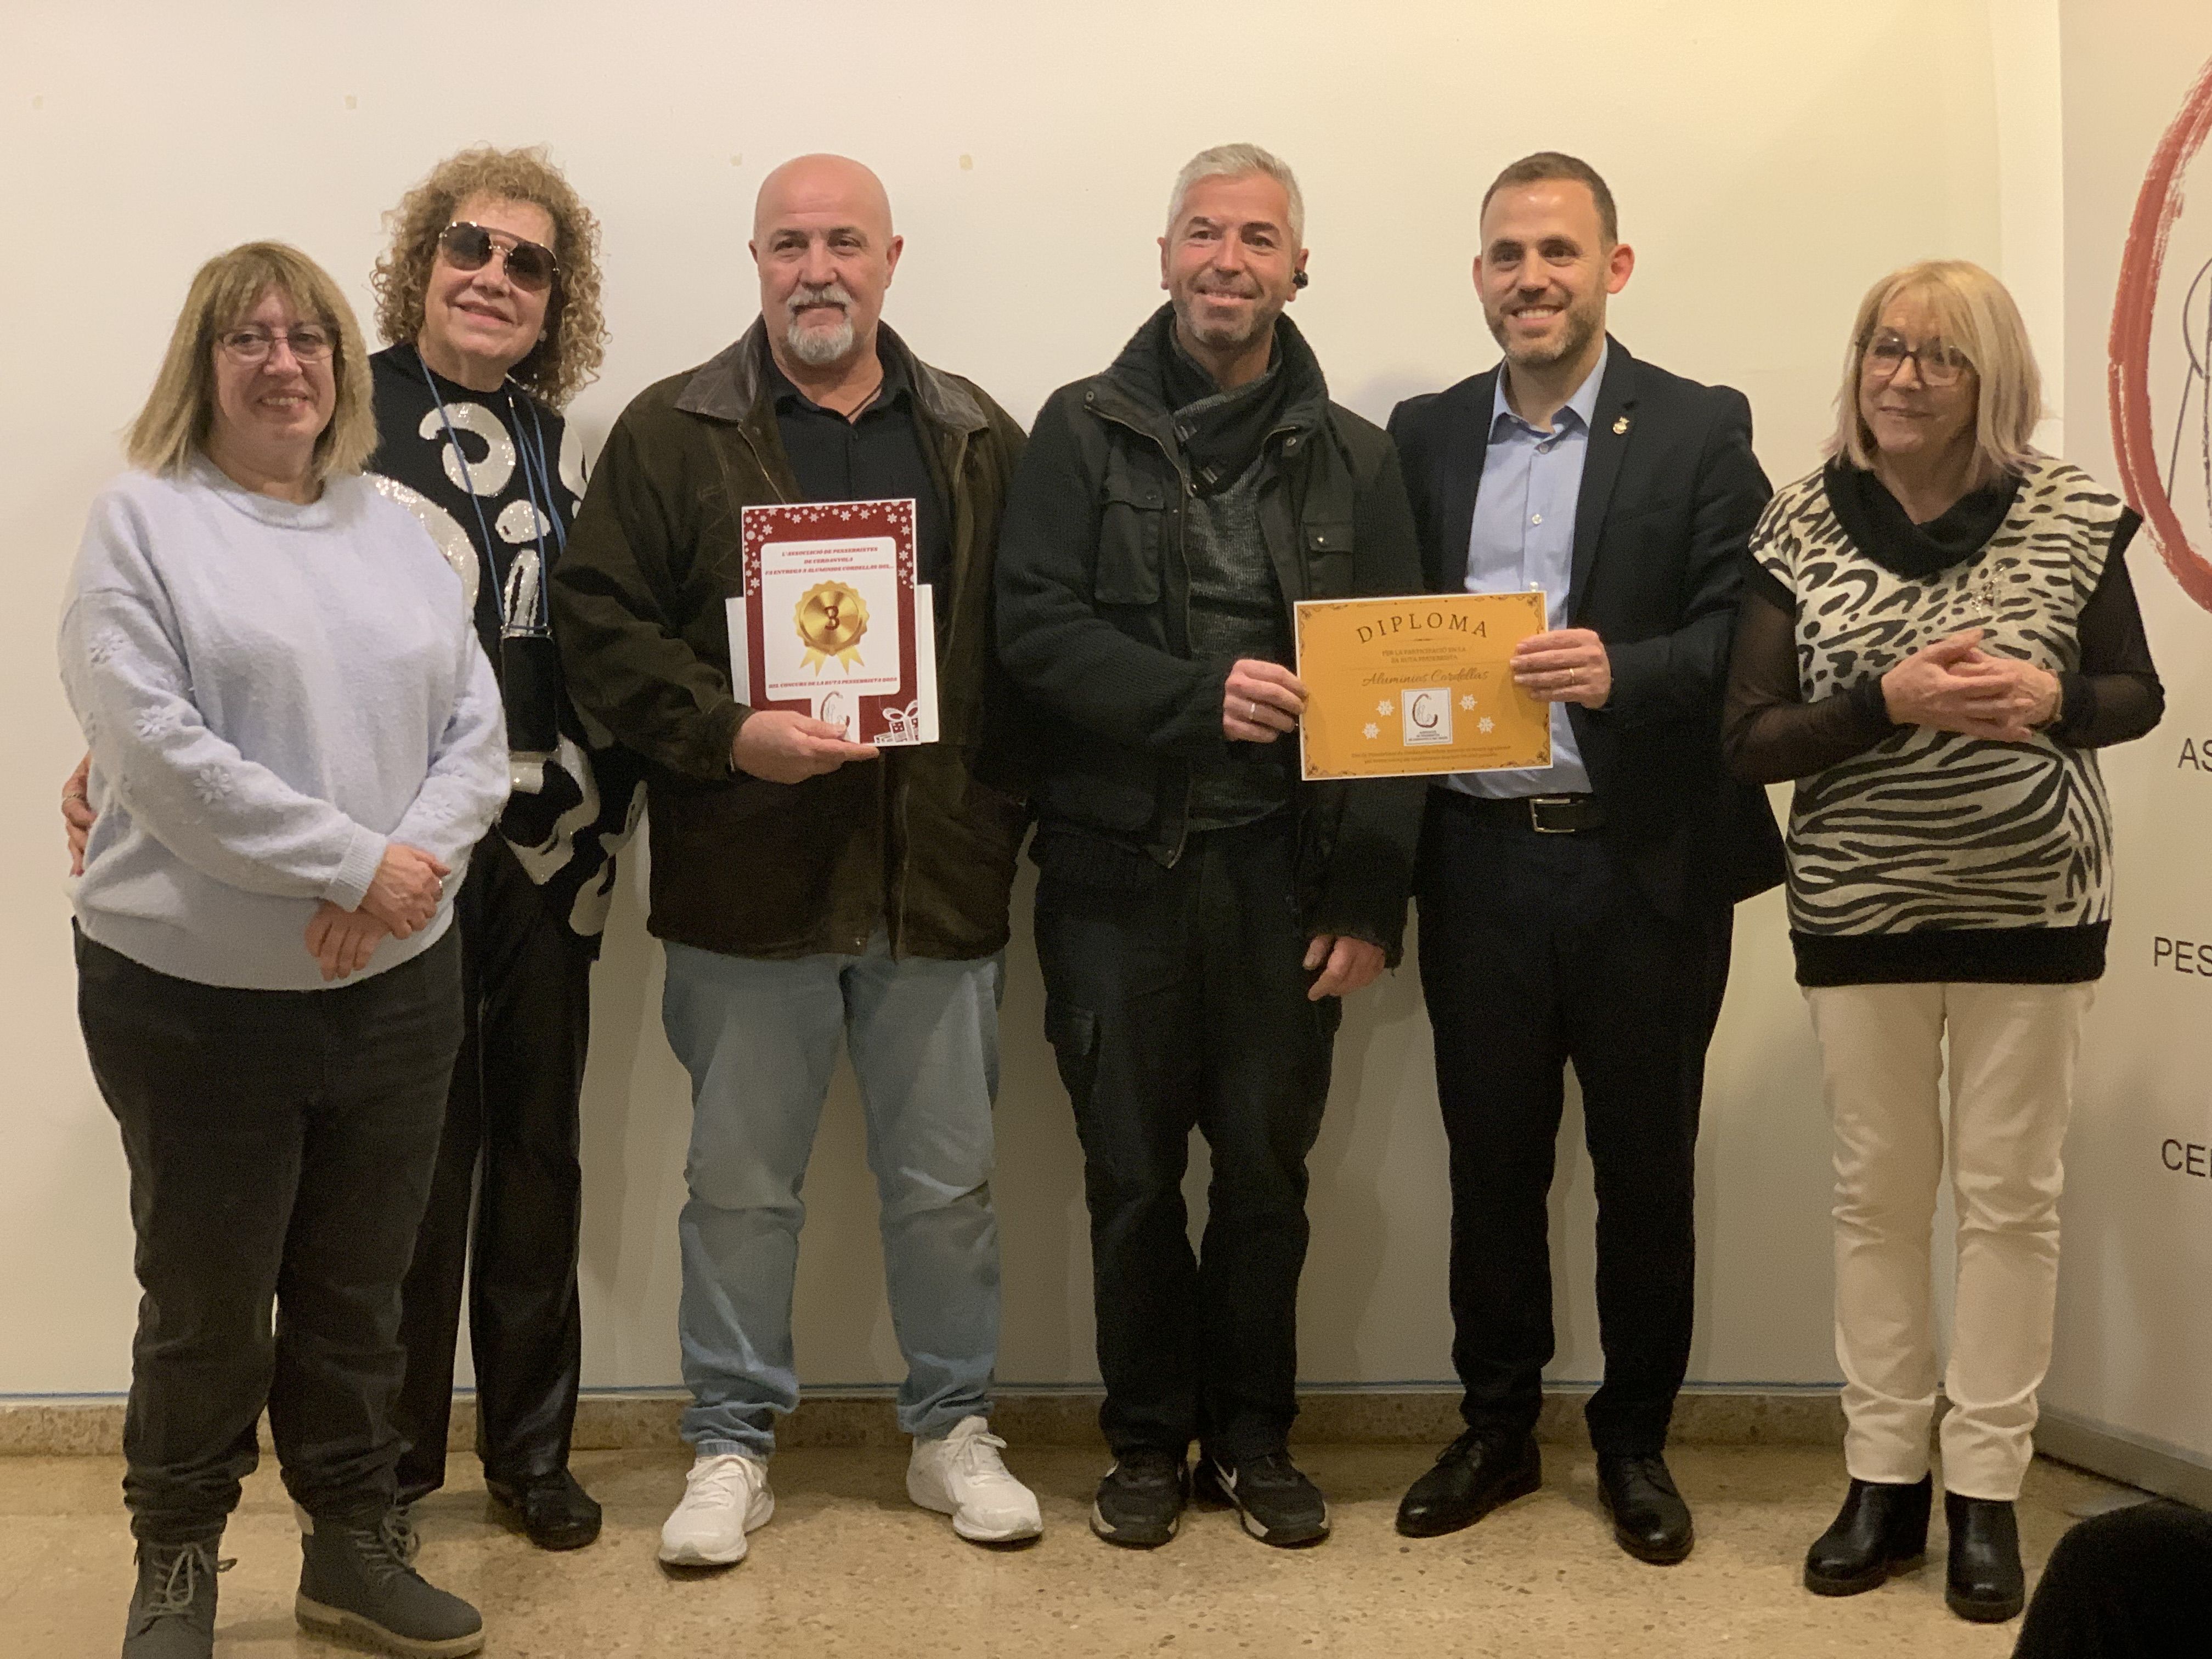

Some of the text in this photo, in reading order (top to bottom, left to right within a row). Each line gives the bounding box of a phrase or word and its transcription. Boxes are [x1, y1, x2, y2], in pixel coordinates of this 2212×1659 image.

[824, 606, 839, 630] 3
[1356, 612, 1487, 644] DIPLOMA
[2154, 936, 2212, 977] PES
[2162, 1139, 2212, 1179] CE
